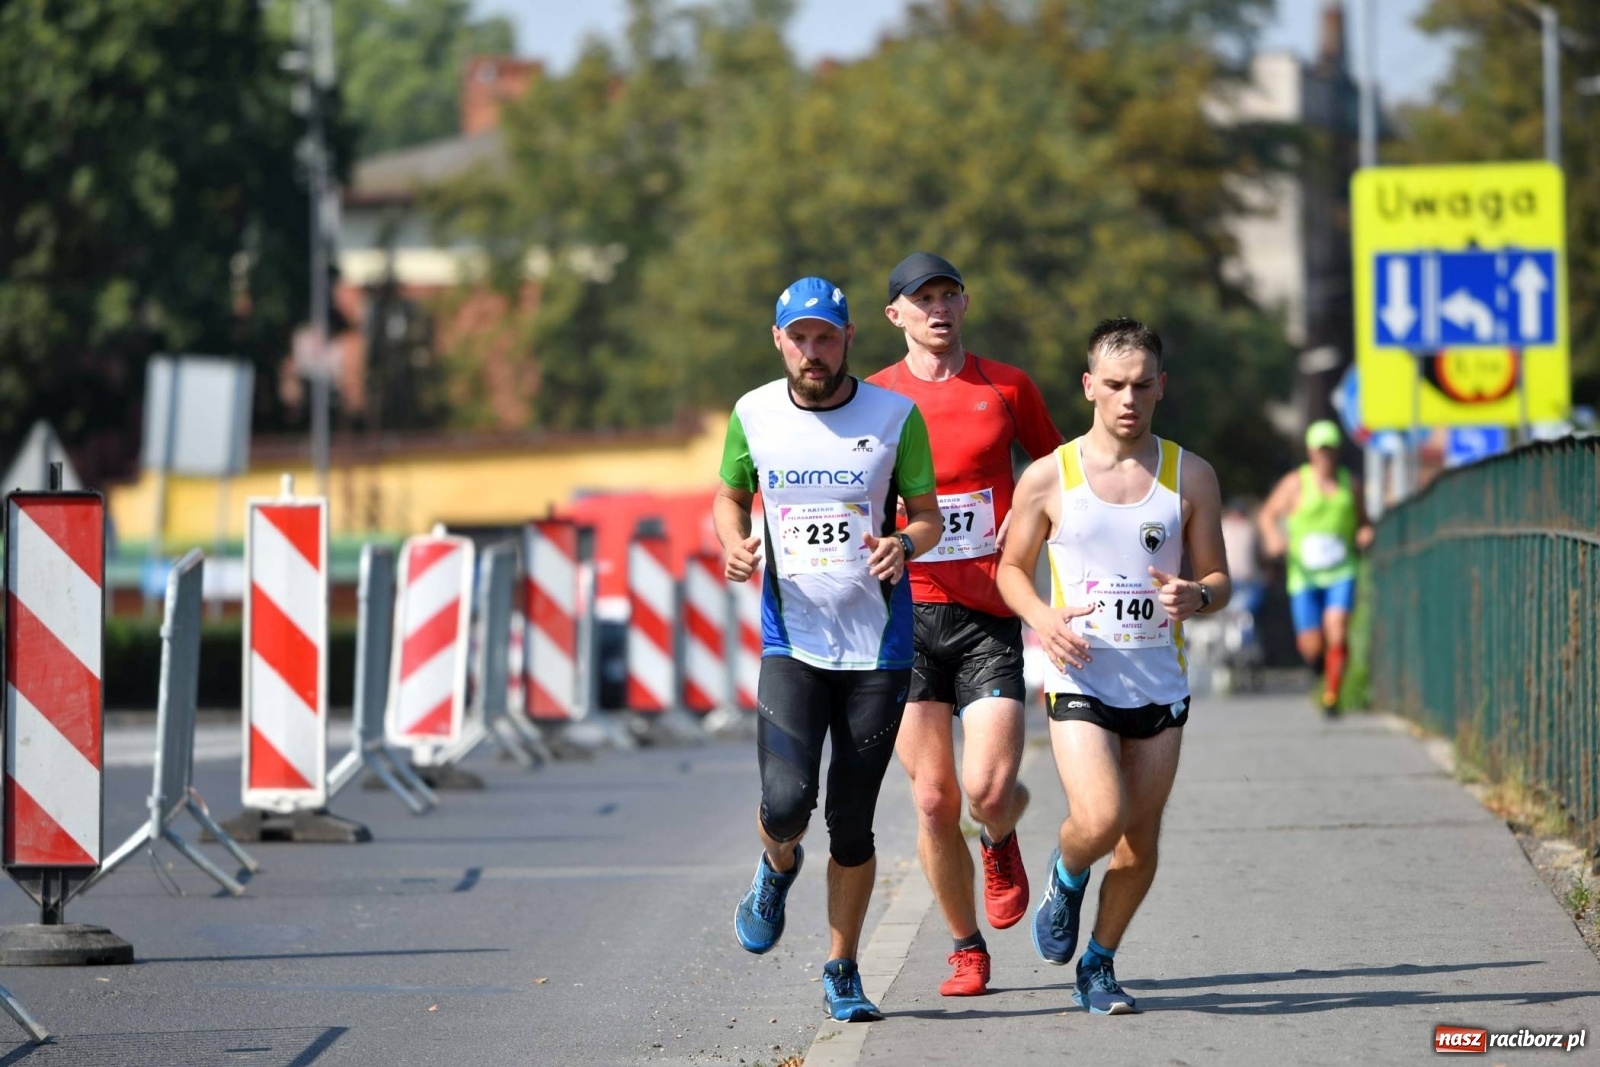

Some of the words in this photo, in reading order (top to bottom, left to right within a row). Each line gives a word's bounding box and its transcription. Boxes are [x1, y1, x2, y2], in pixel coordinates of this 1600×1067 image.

[1375, 181, 1538, 229] Uwaga
[806, 521, 851, 545] 235
[1114, 598, 1154, 621] 140
